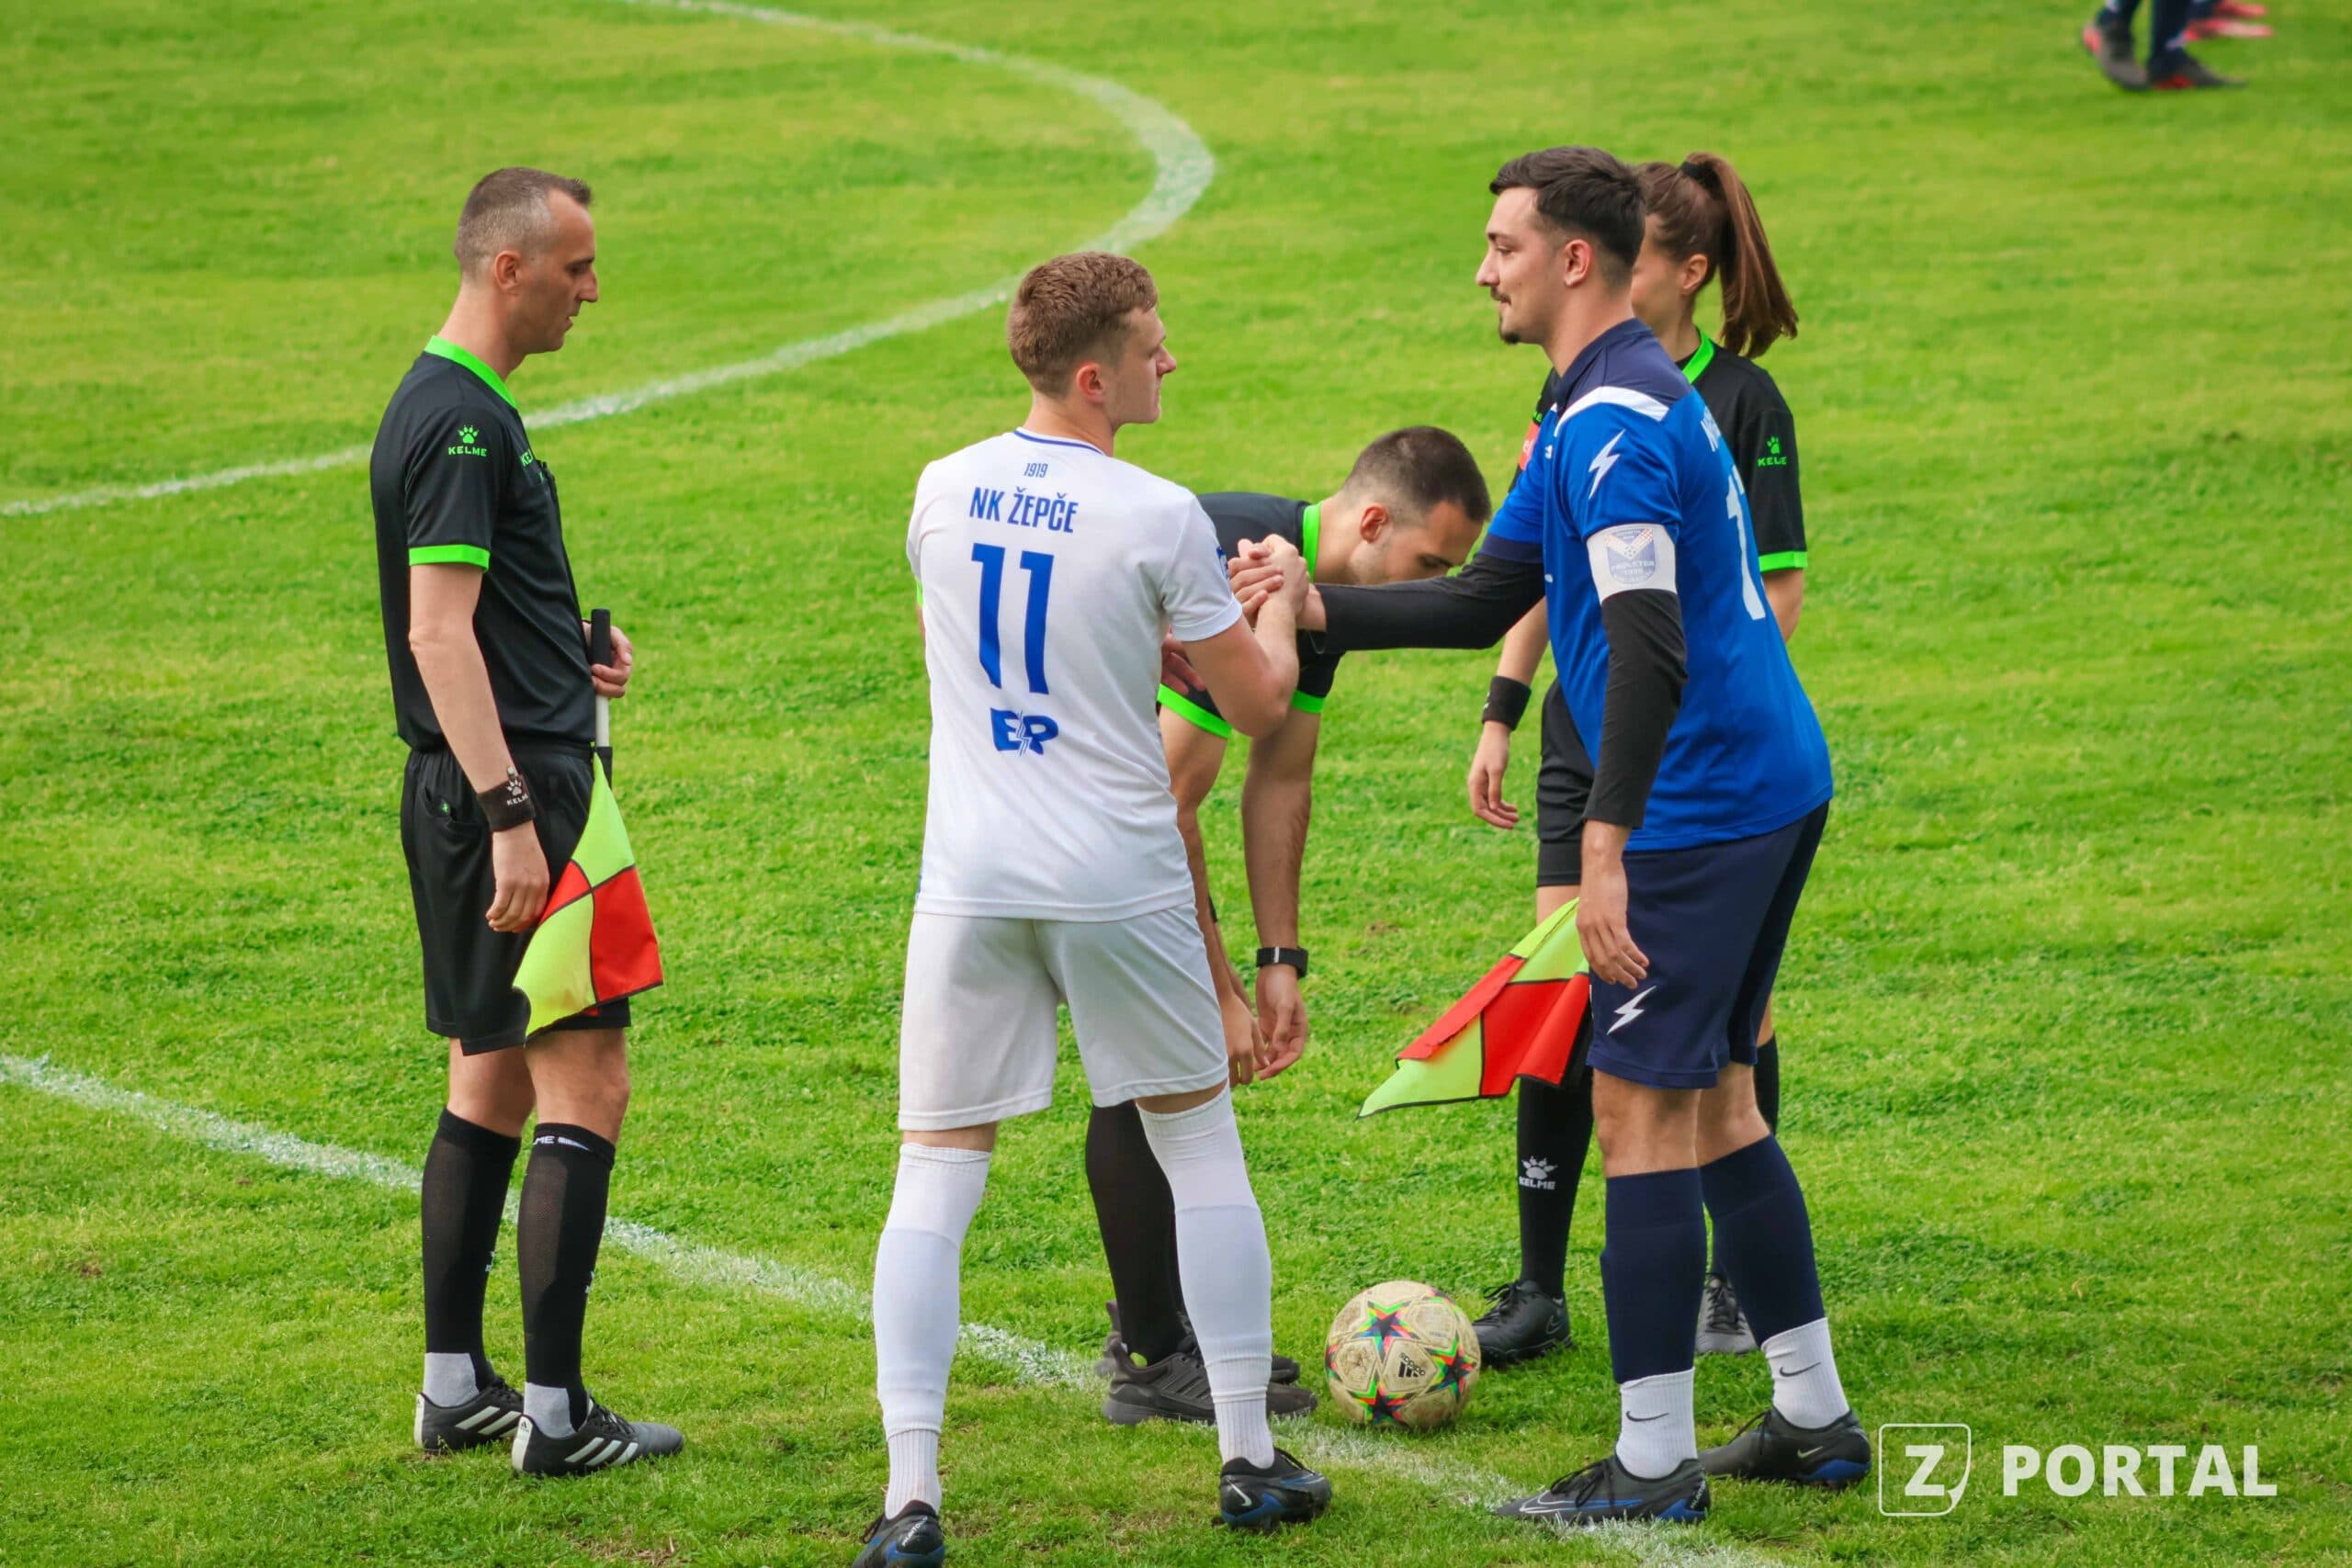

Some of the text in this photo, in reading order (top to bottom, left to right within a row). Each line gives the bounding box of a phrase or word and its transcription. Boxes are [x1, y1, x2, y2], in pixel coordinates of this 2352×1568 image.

[447, 446, 488, 457] KELME
[1023, 462, 1049, 479] 1919
[969, 485, 1080, 534] NK ŽEPČE
[970, 542, 1055, 696] 11
[1518, 1176, 1555, 1191] KELME
